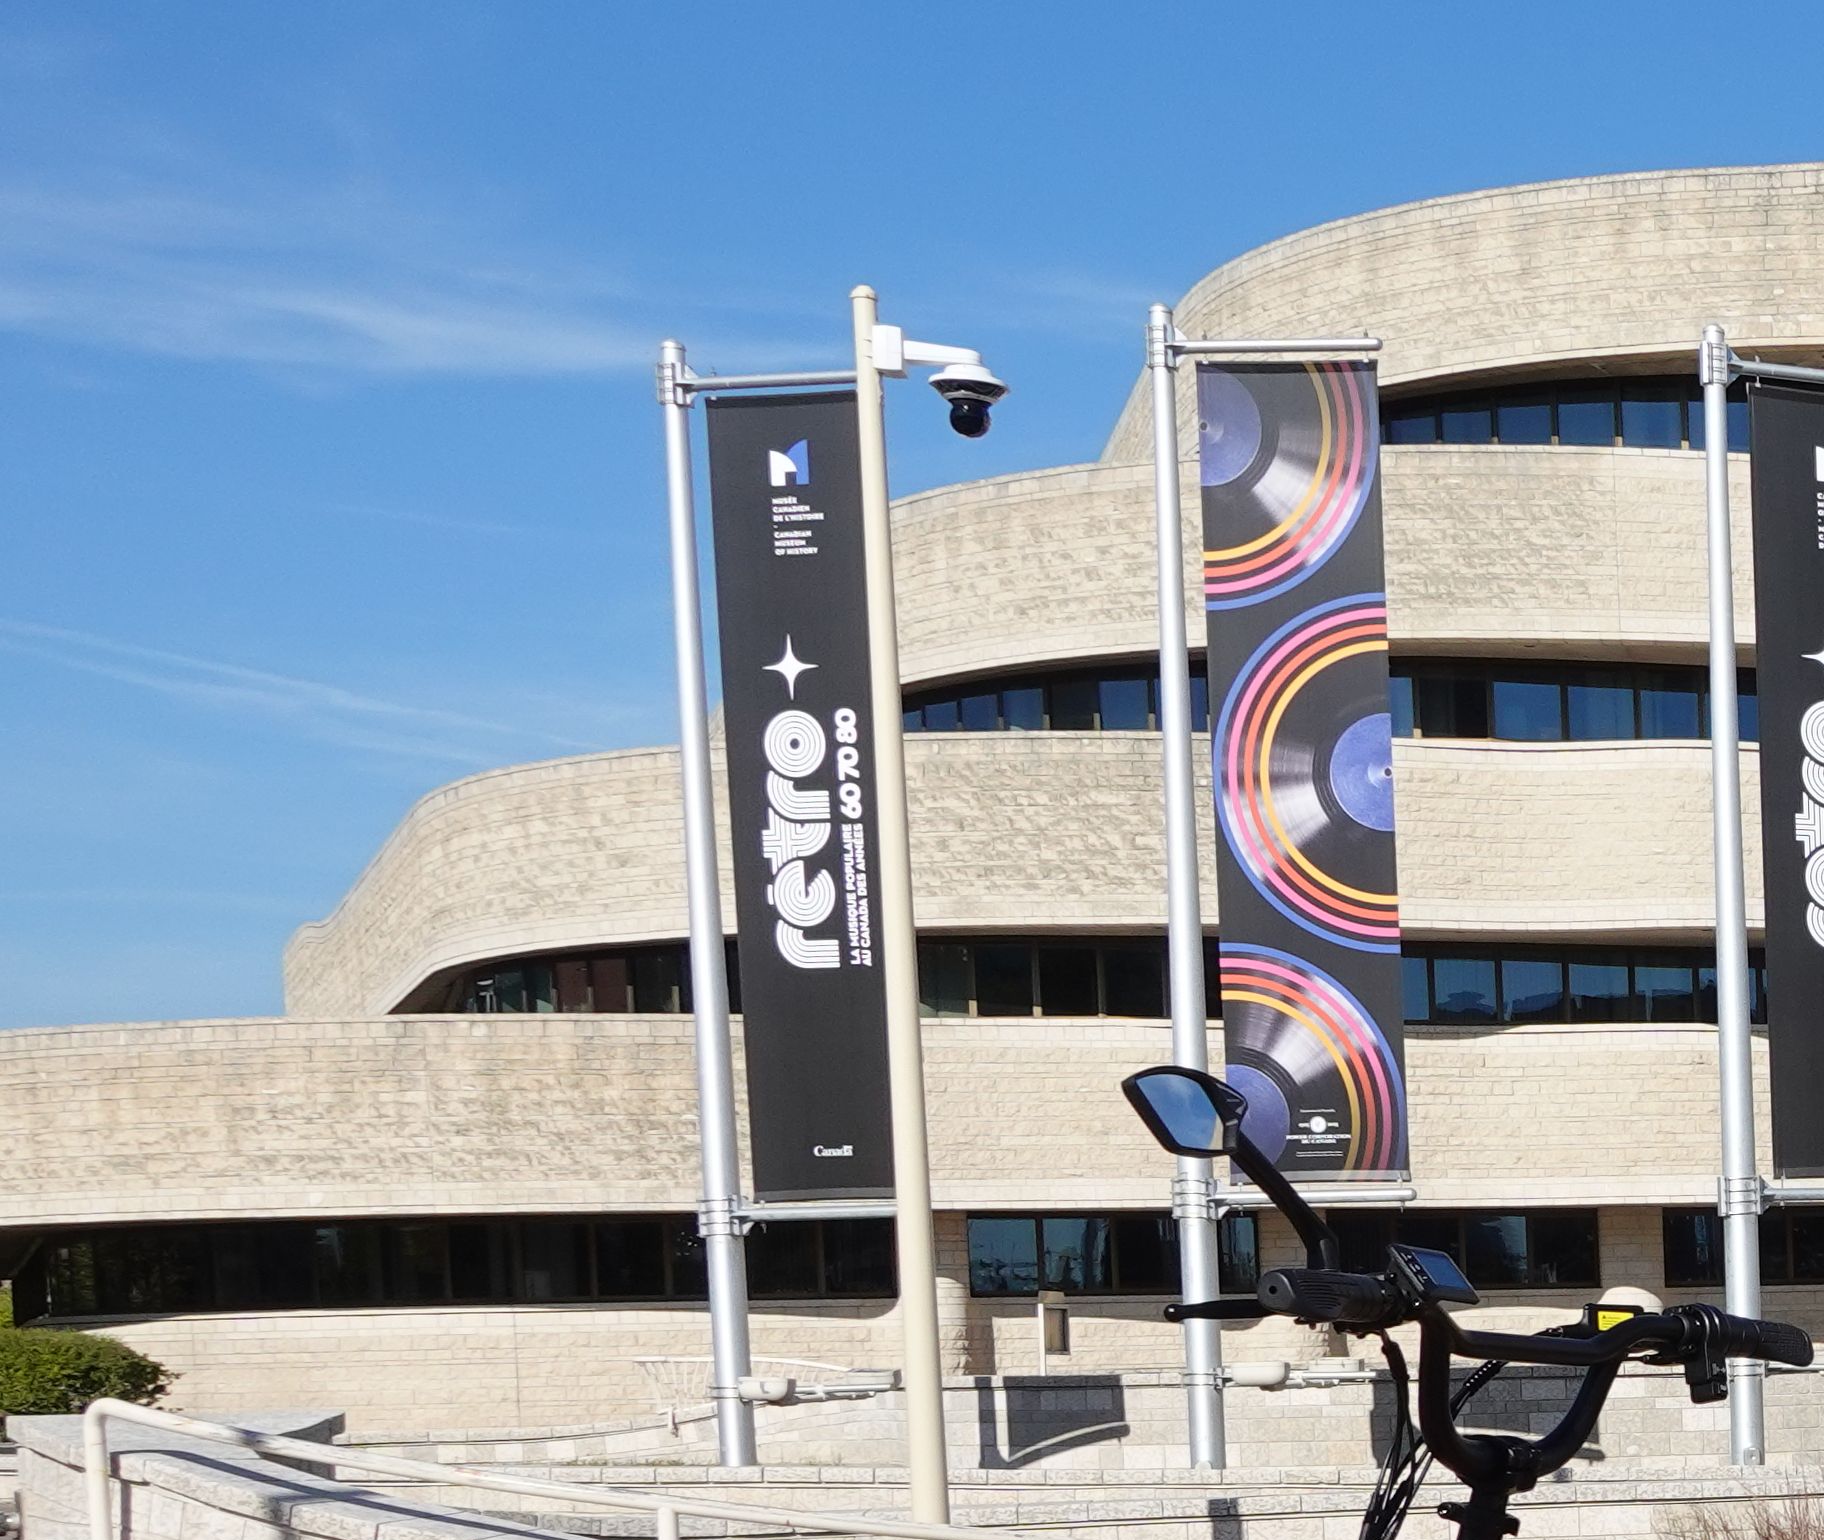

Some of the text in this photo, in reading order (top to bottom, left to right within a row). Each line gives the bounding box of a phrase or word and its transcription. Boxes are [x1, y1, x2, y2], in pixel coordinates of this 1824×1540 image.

[834, 708, 862, 819] 60 70 80
[841, 824, 861, 965] LA MUSIQUE POPULAIRE
[856, 873, 867, 896] DES
[858, 898, 871, 948] CANADA
[861, 949, 872, 967] AU
